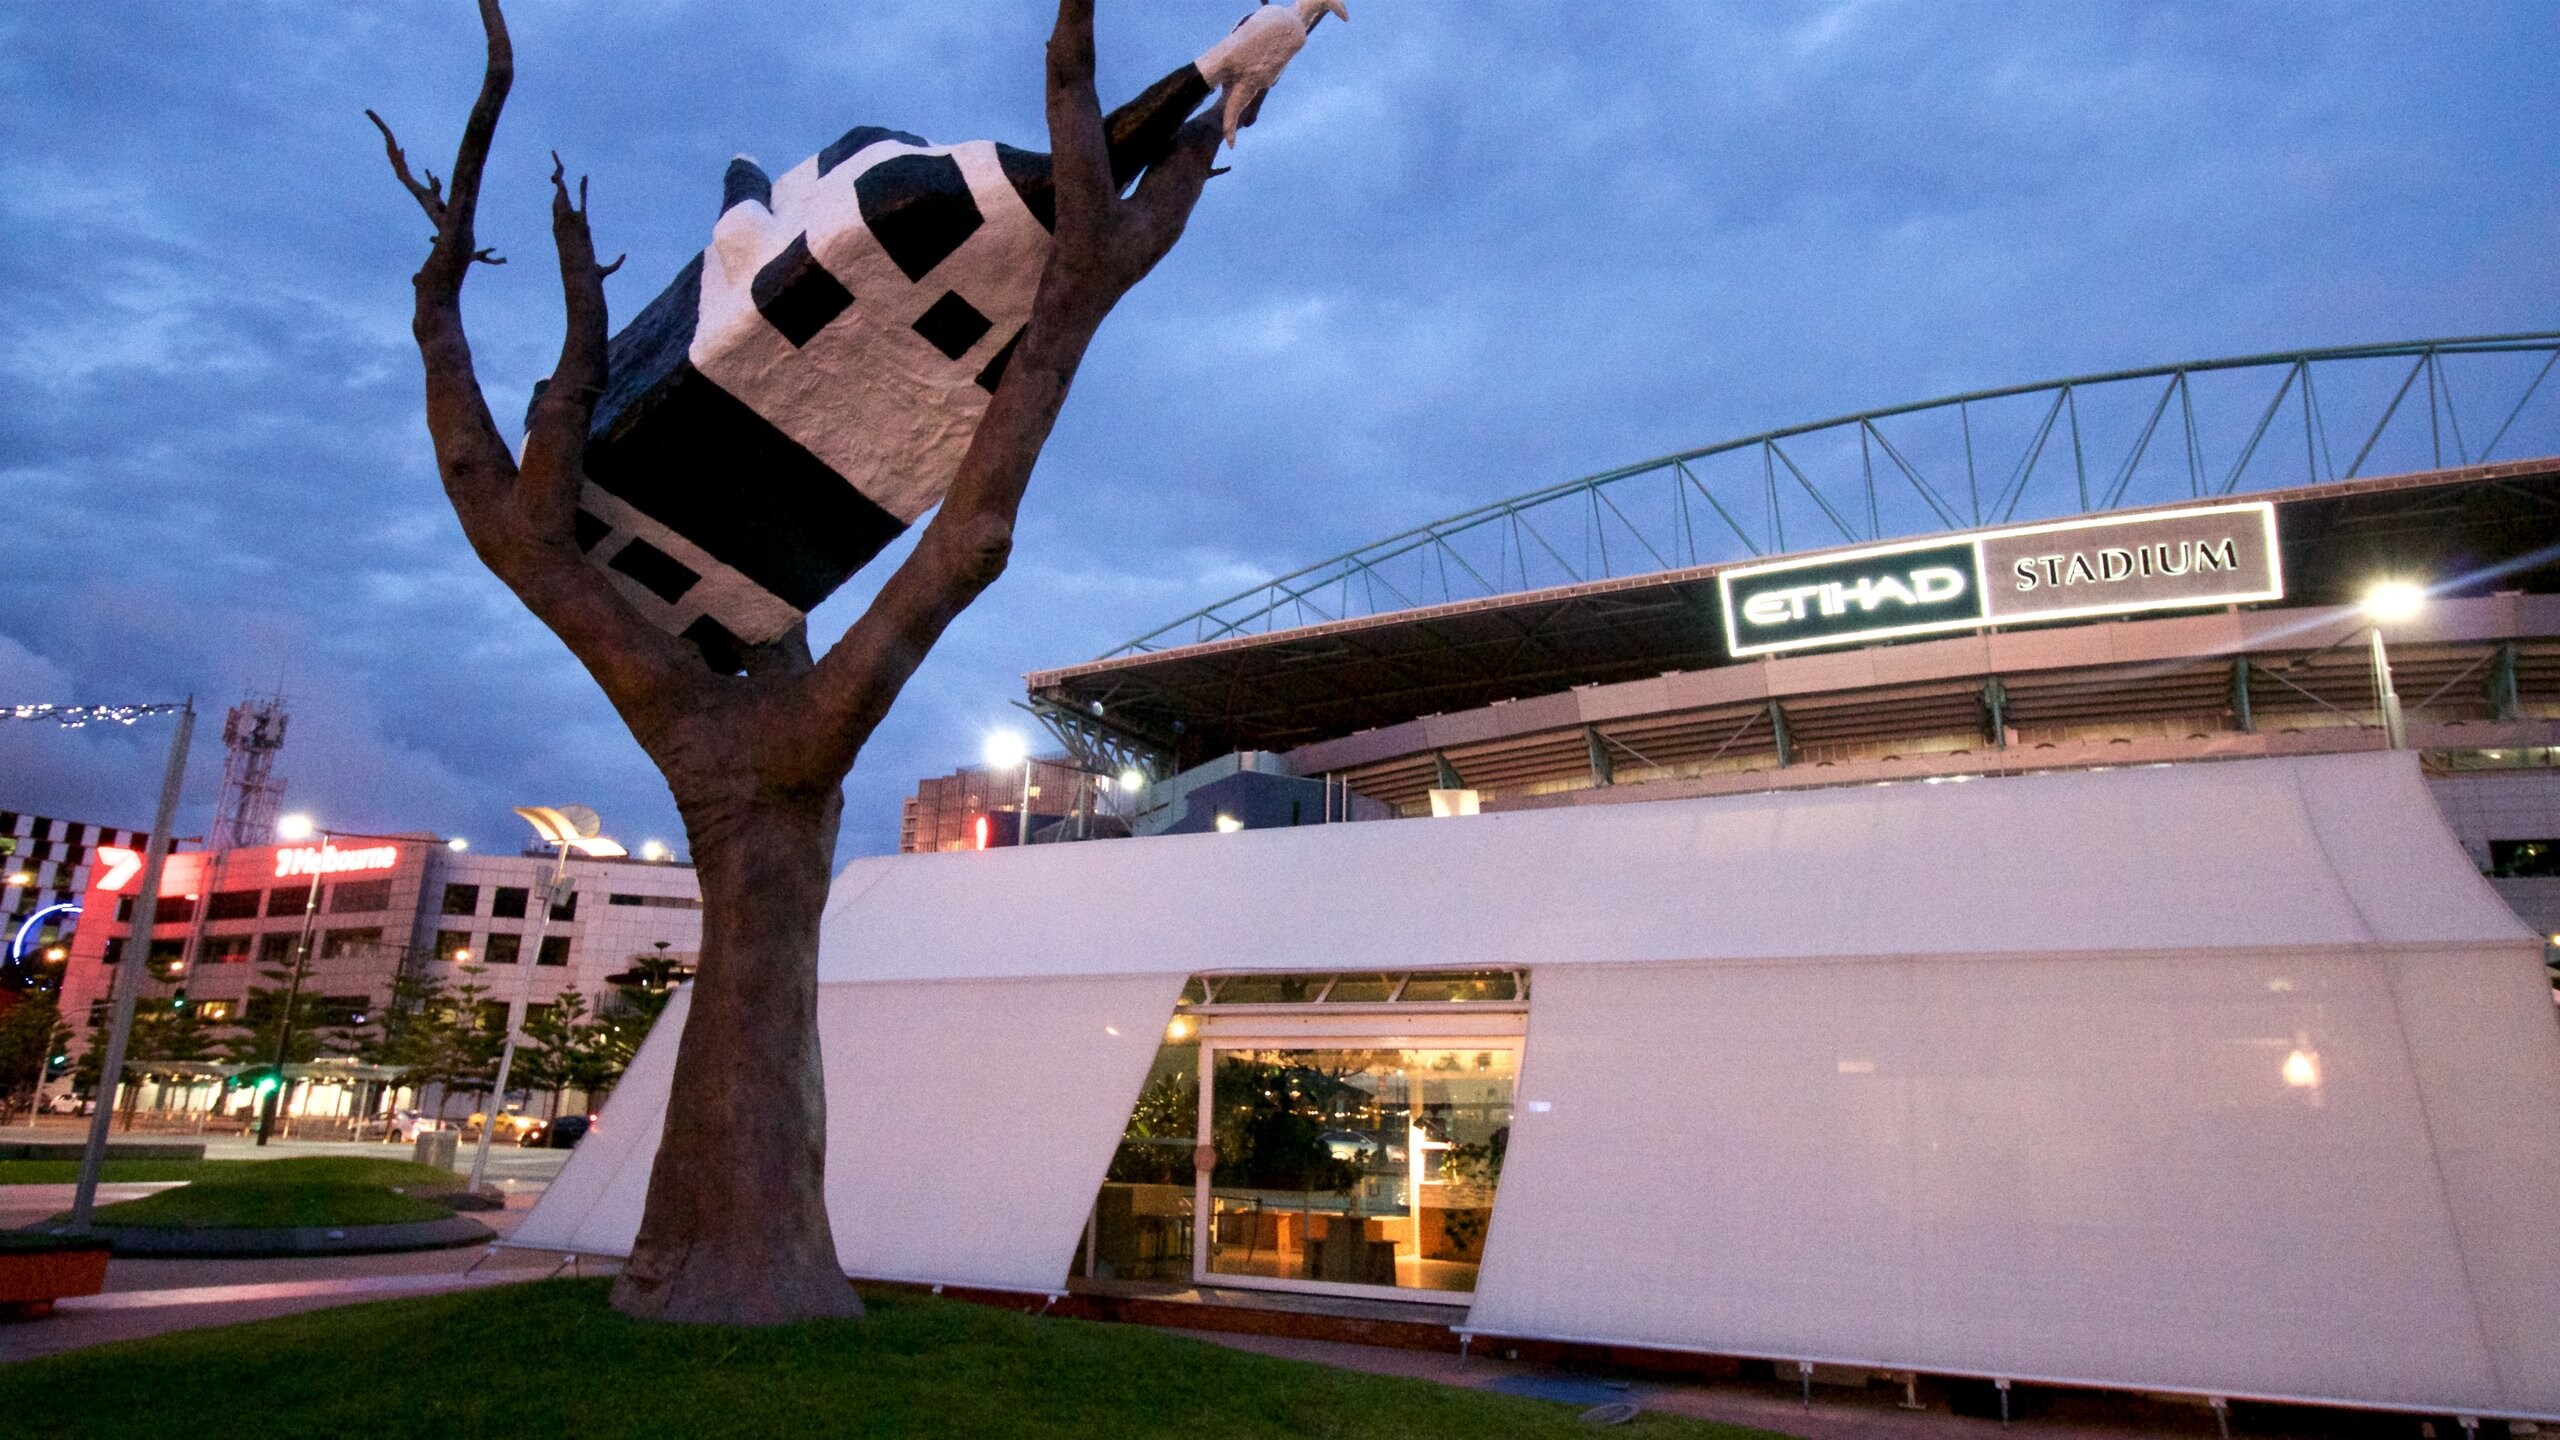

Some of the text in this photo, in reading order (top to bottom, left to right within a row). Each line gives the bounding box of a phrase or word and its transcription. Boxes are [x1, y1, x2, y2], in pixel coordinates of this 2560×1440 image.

[1744, 538, 2238, 624] ETIHAD STADIUM
[96, 846, 142, 891] 7
